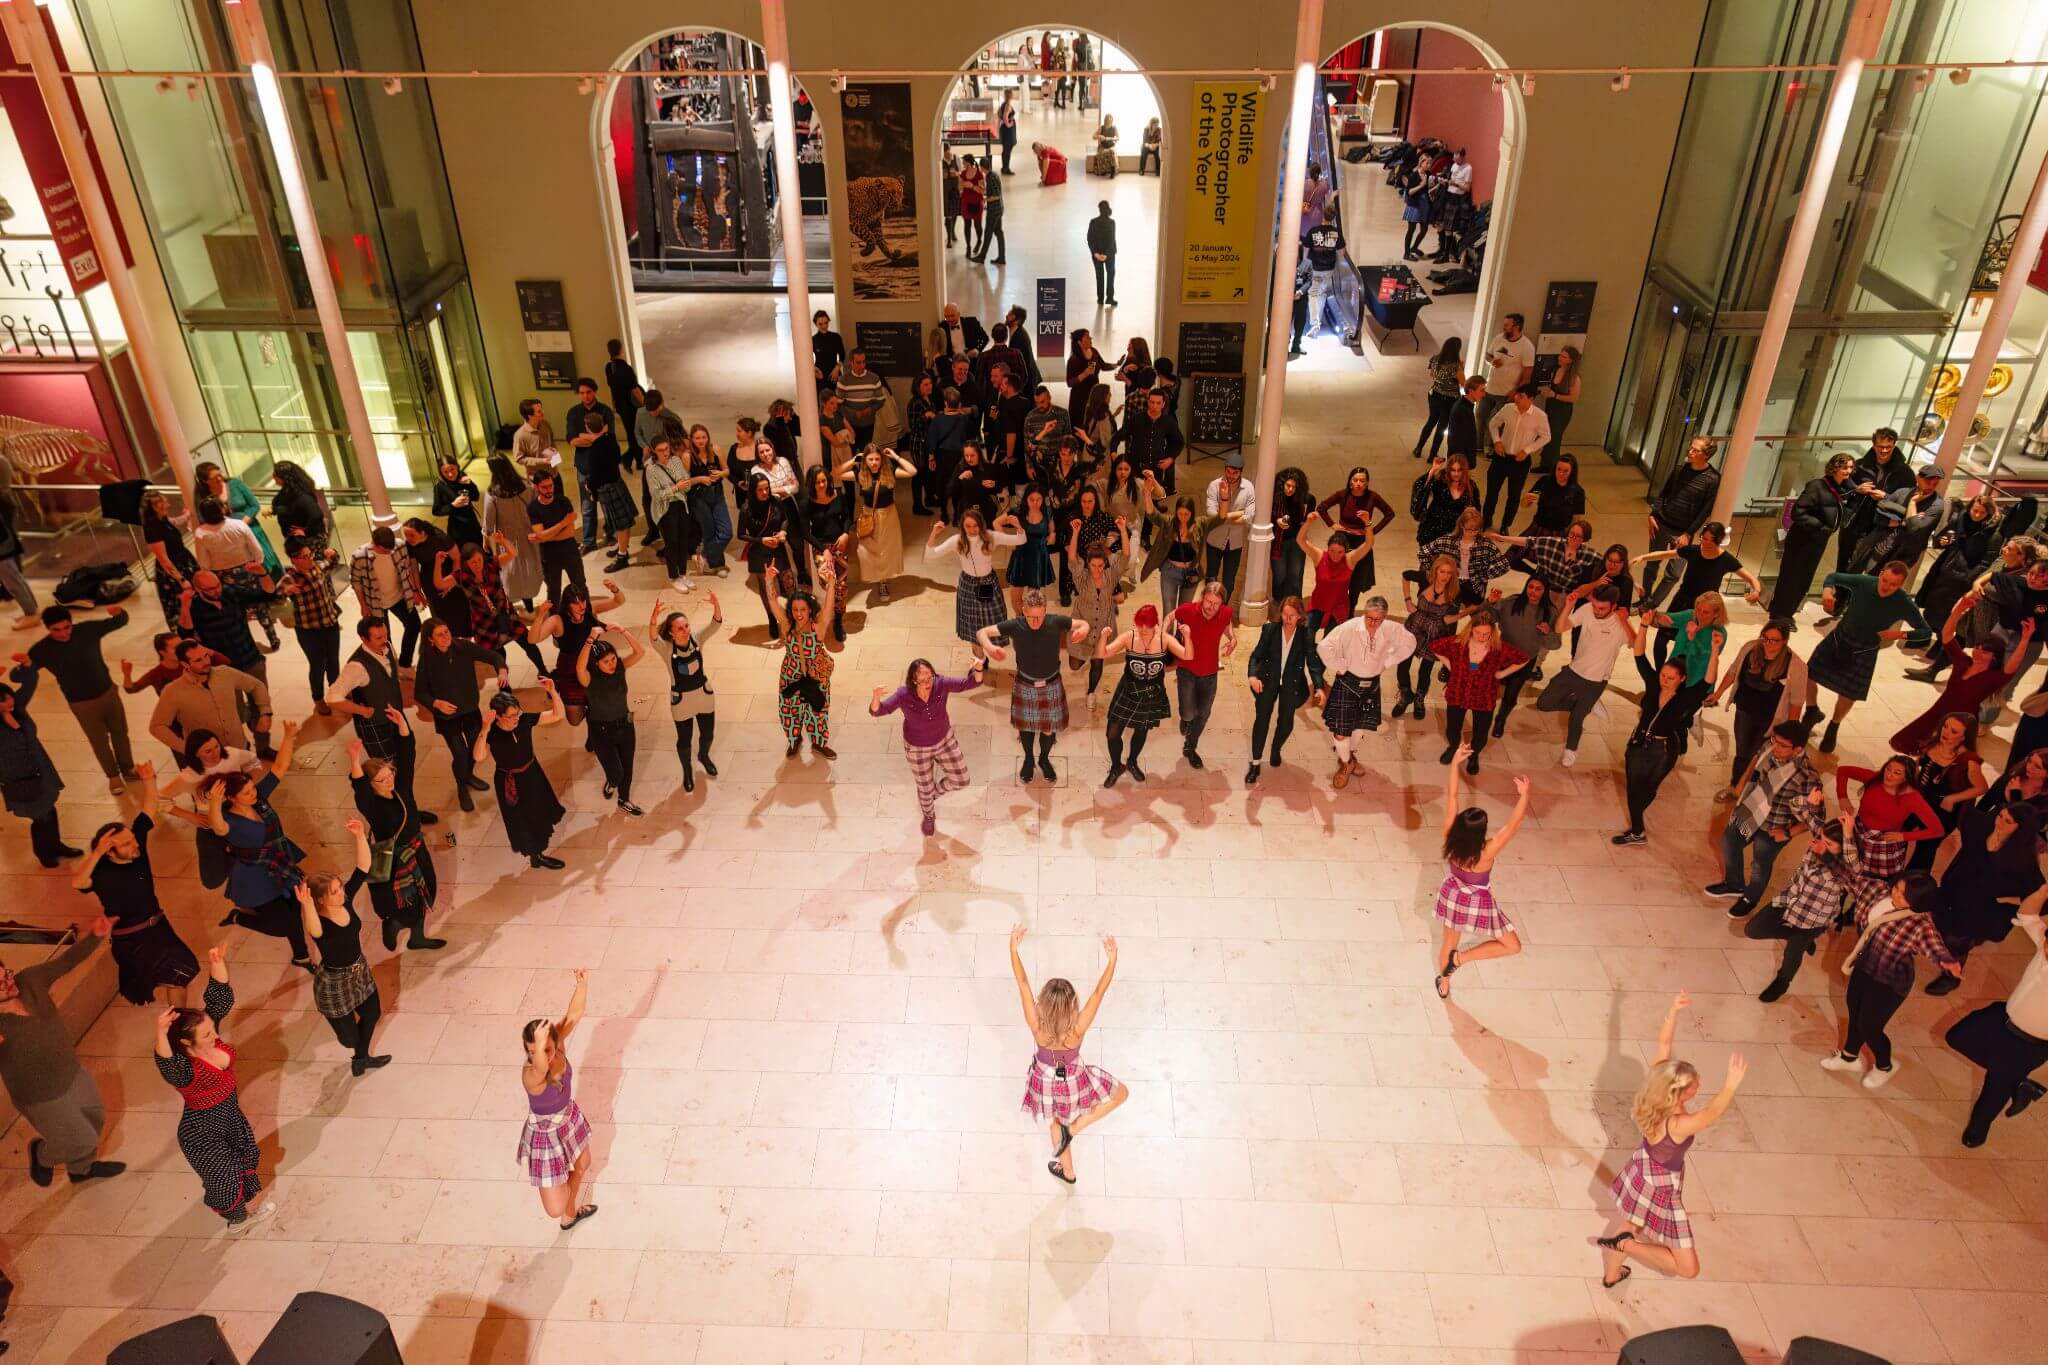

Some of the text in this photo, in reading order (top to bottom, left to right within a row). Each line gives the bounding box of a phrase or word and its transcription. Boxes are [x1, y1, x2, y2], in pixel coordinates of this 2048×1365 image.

[1237, 91, 1258, 165] Wildlife
[1195, 92, 1215, 195] of the Year
[1214, 92, 1238, 225] Photographer
[1189, 244, 1233, 253] 20 January
[73, 257, 96, 275] Exit
[1201, 254, 1218, 263] May
[1219, 254, 1241, 262] 2024
[1040, 325, 1063, 335] LATE
